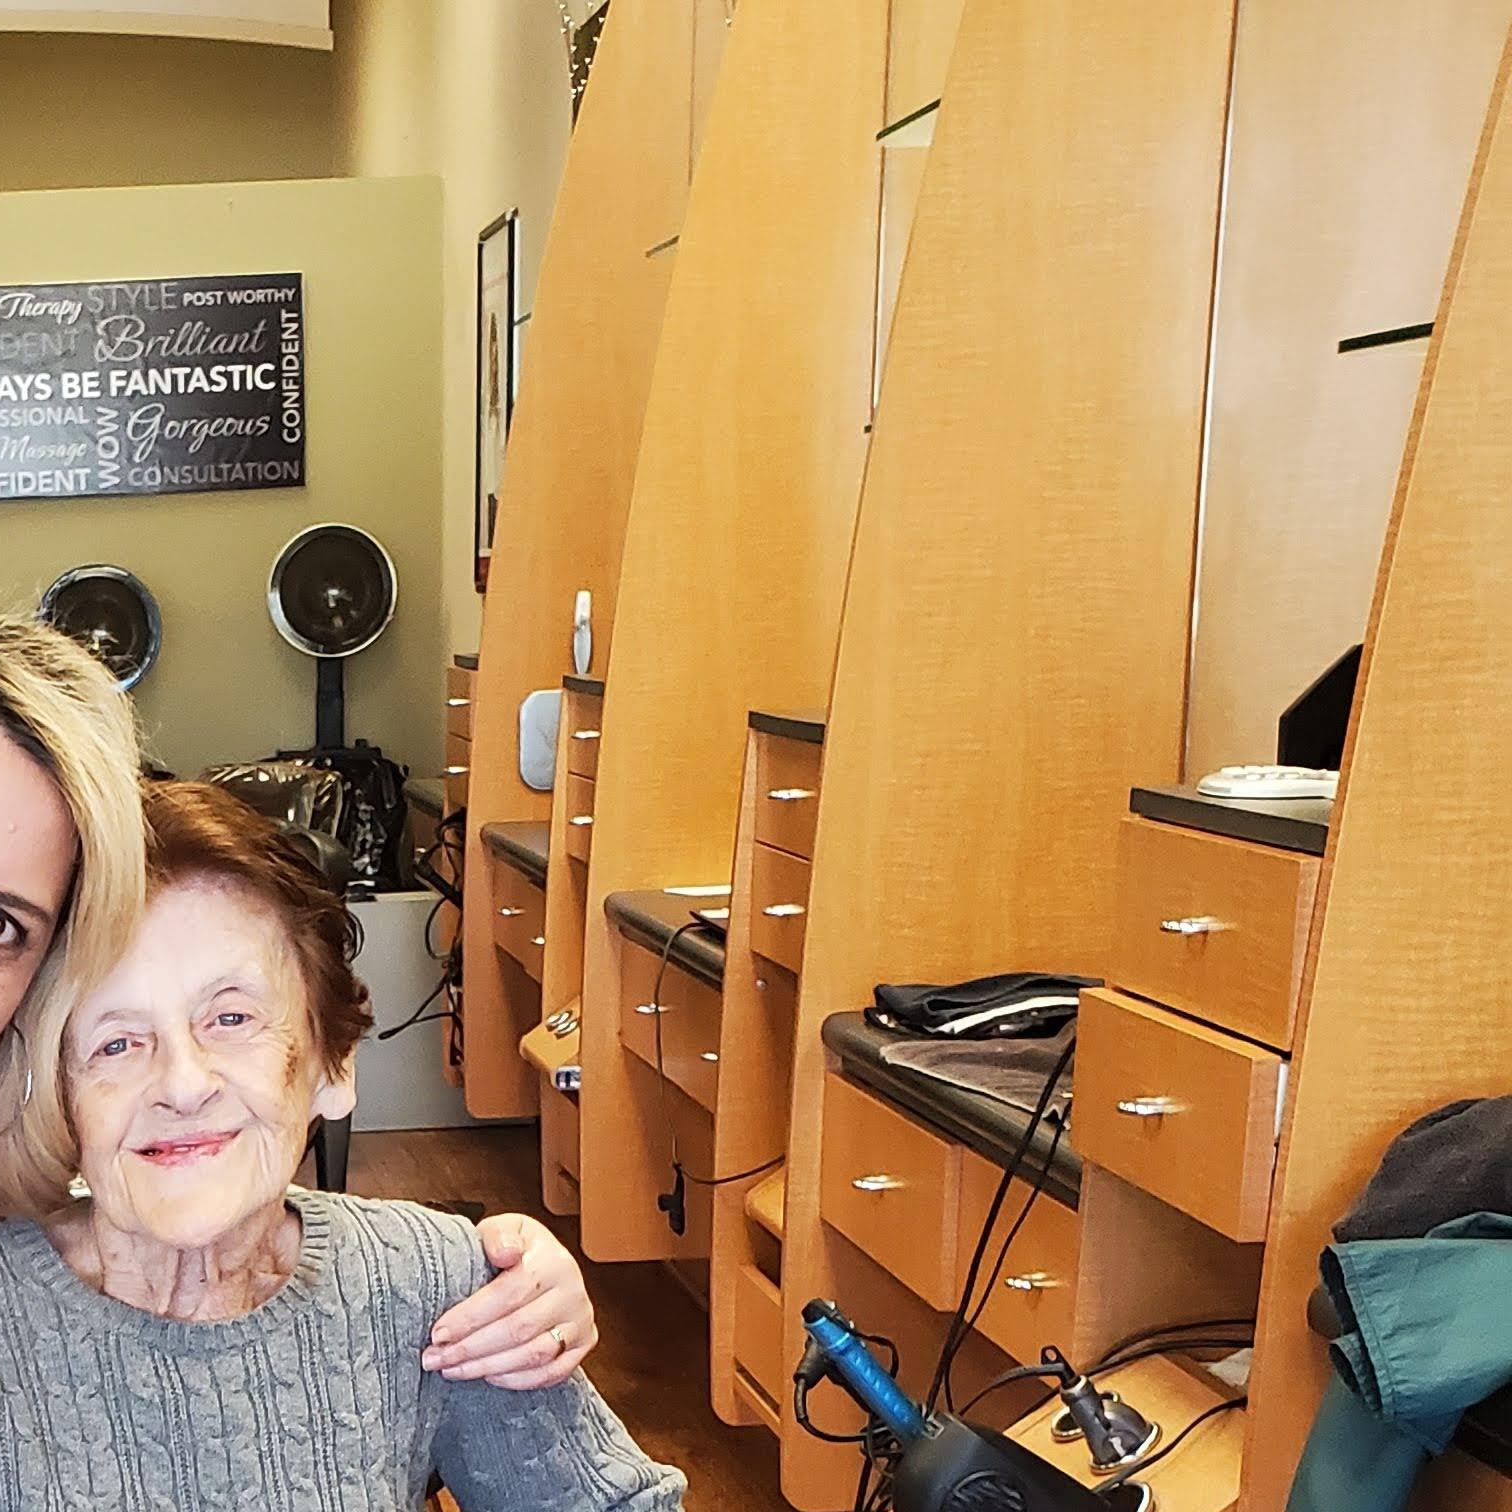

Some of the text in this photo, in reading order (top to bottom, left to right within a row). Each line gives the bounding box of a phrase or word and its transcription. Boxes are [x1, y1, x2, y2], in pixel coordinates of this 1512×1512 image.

[88, 282, 178, 314] STYLE
[182, 287, 296, 307] POST WORTHY
[94, 314, 268, 362] Brilliant
[61, 371, 102, 400] BE
[109, 362, 276, 397] FANTASTIC
[280, 309, 301, 443] CONFIDENT
[95, 406, 121, 490] WOW
[126, 402, 271, 463] Gorgeous
[128, 459, 300, 488] CONSULTATION
